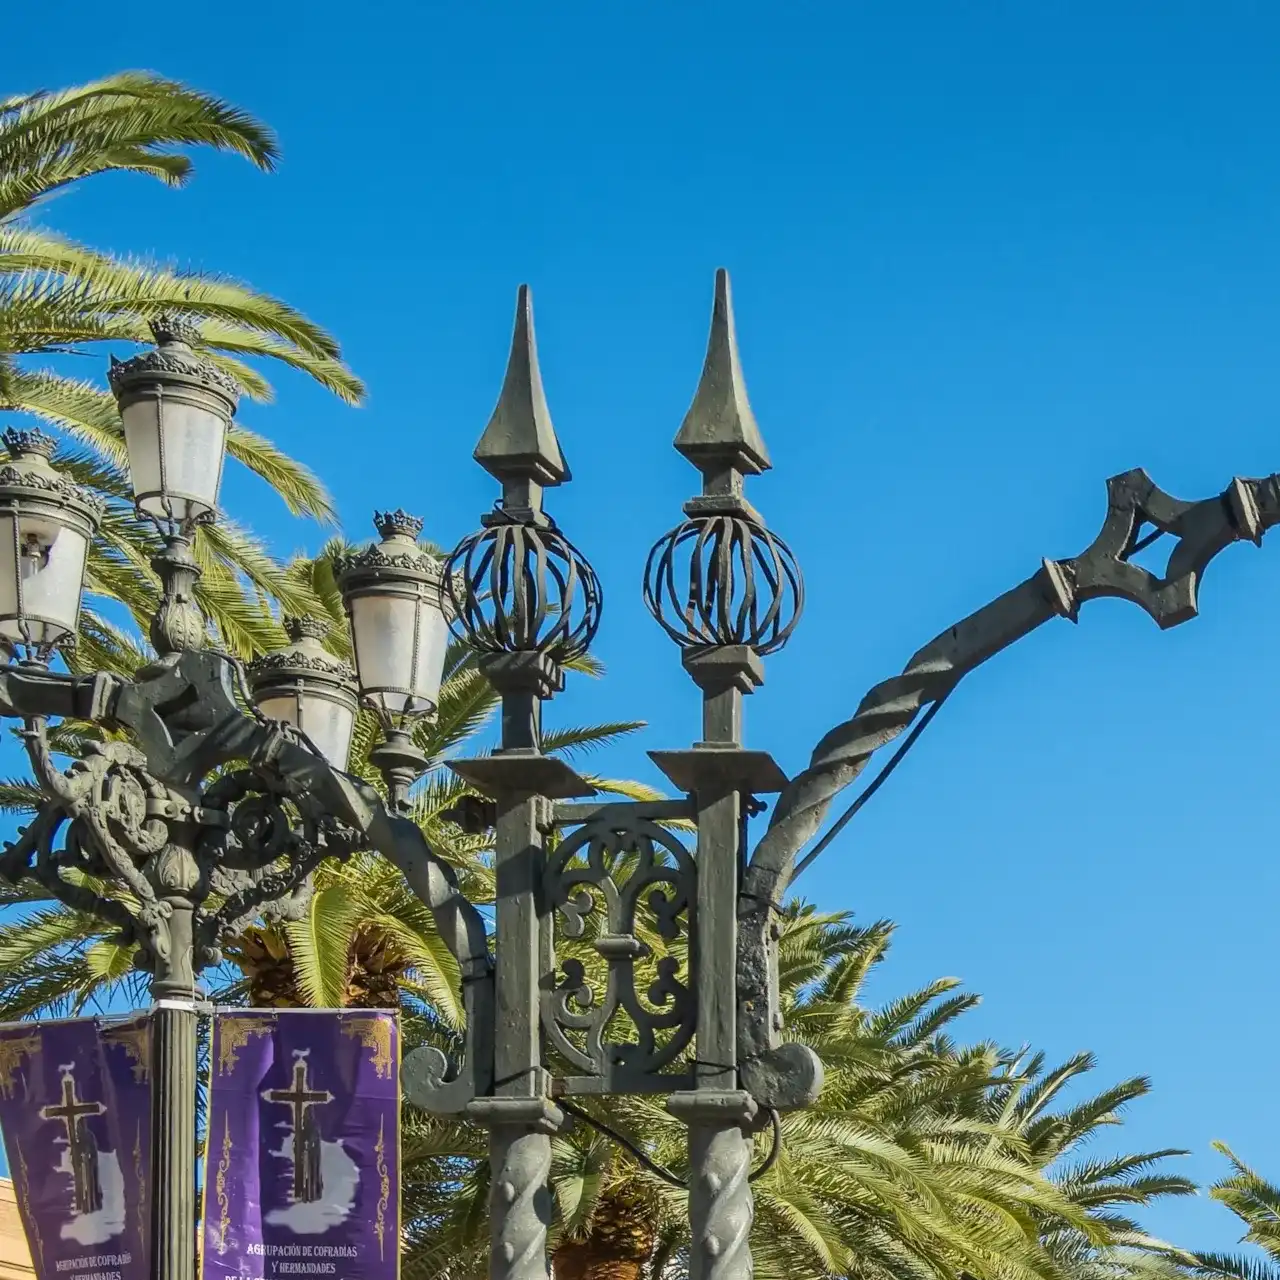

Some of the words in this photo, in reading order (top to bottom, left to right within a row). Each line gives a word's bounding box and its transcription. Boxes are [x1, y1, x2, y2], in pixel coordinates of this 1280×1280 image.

[247, 1243, 302, 1257] AGRUPACIÓN
[303, 1245, 312, 1257] DE
[314, 1244, 357, 1257] COFRADÍAS
[272, 1261, 278, 1273] Y
[279, 1263, 336, 1274] HERMANDADES
